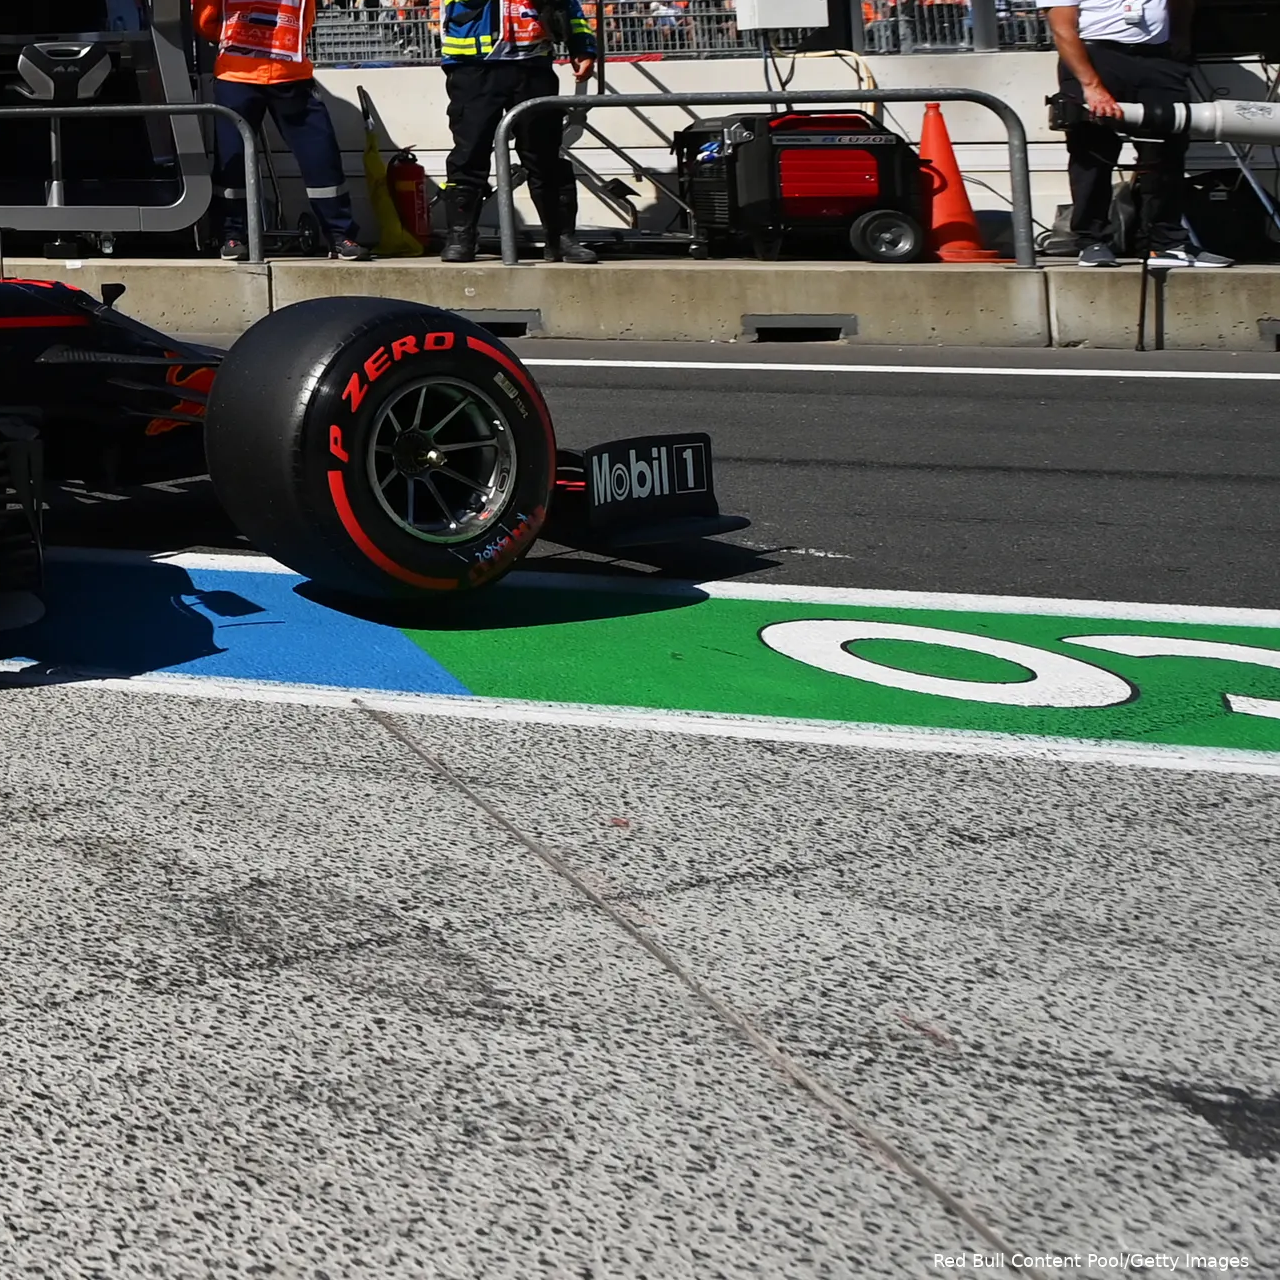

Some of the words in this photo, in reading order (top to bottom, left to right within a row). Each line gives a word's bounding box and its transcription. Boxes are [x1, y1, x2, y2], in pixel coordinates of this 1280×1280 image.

[329, 424, 349, 464] P
[341, 331, 456, 413] ZERO
[592, 446, 670, 507] Mobil
